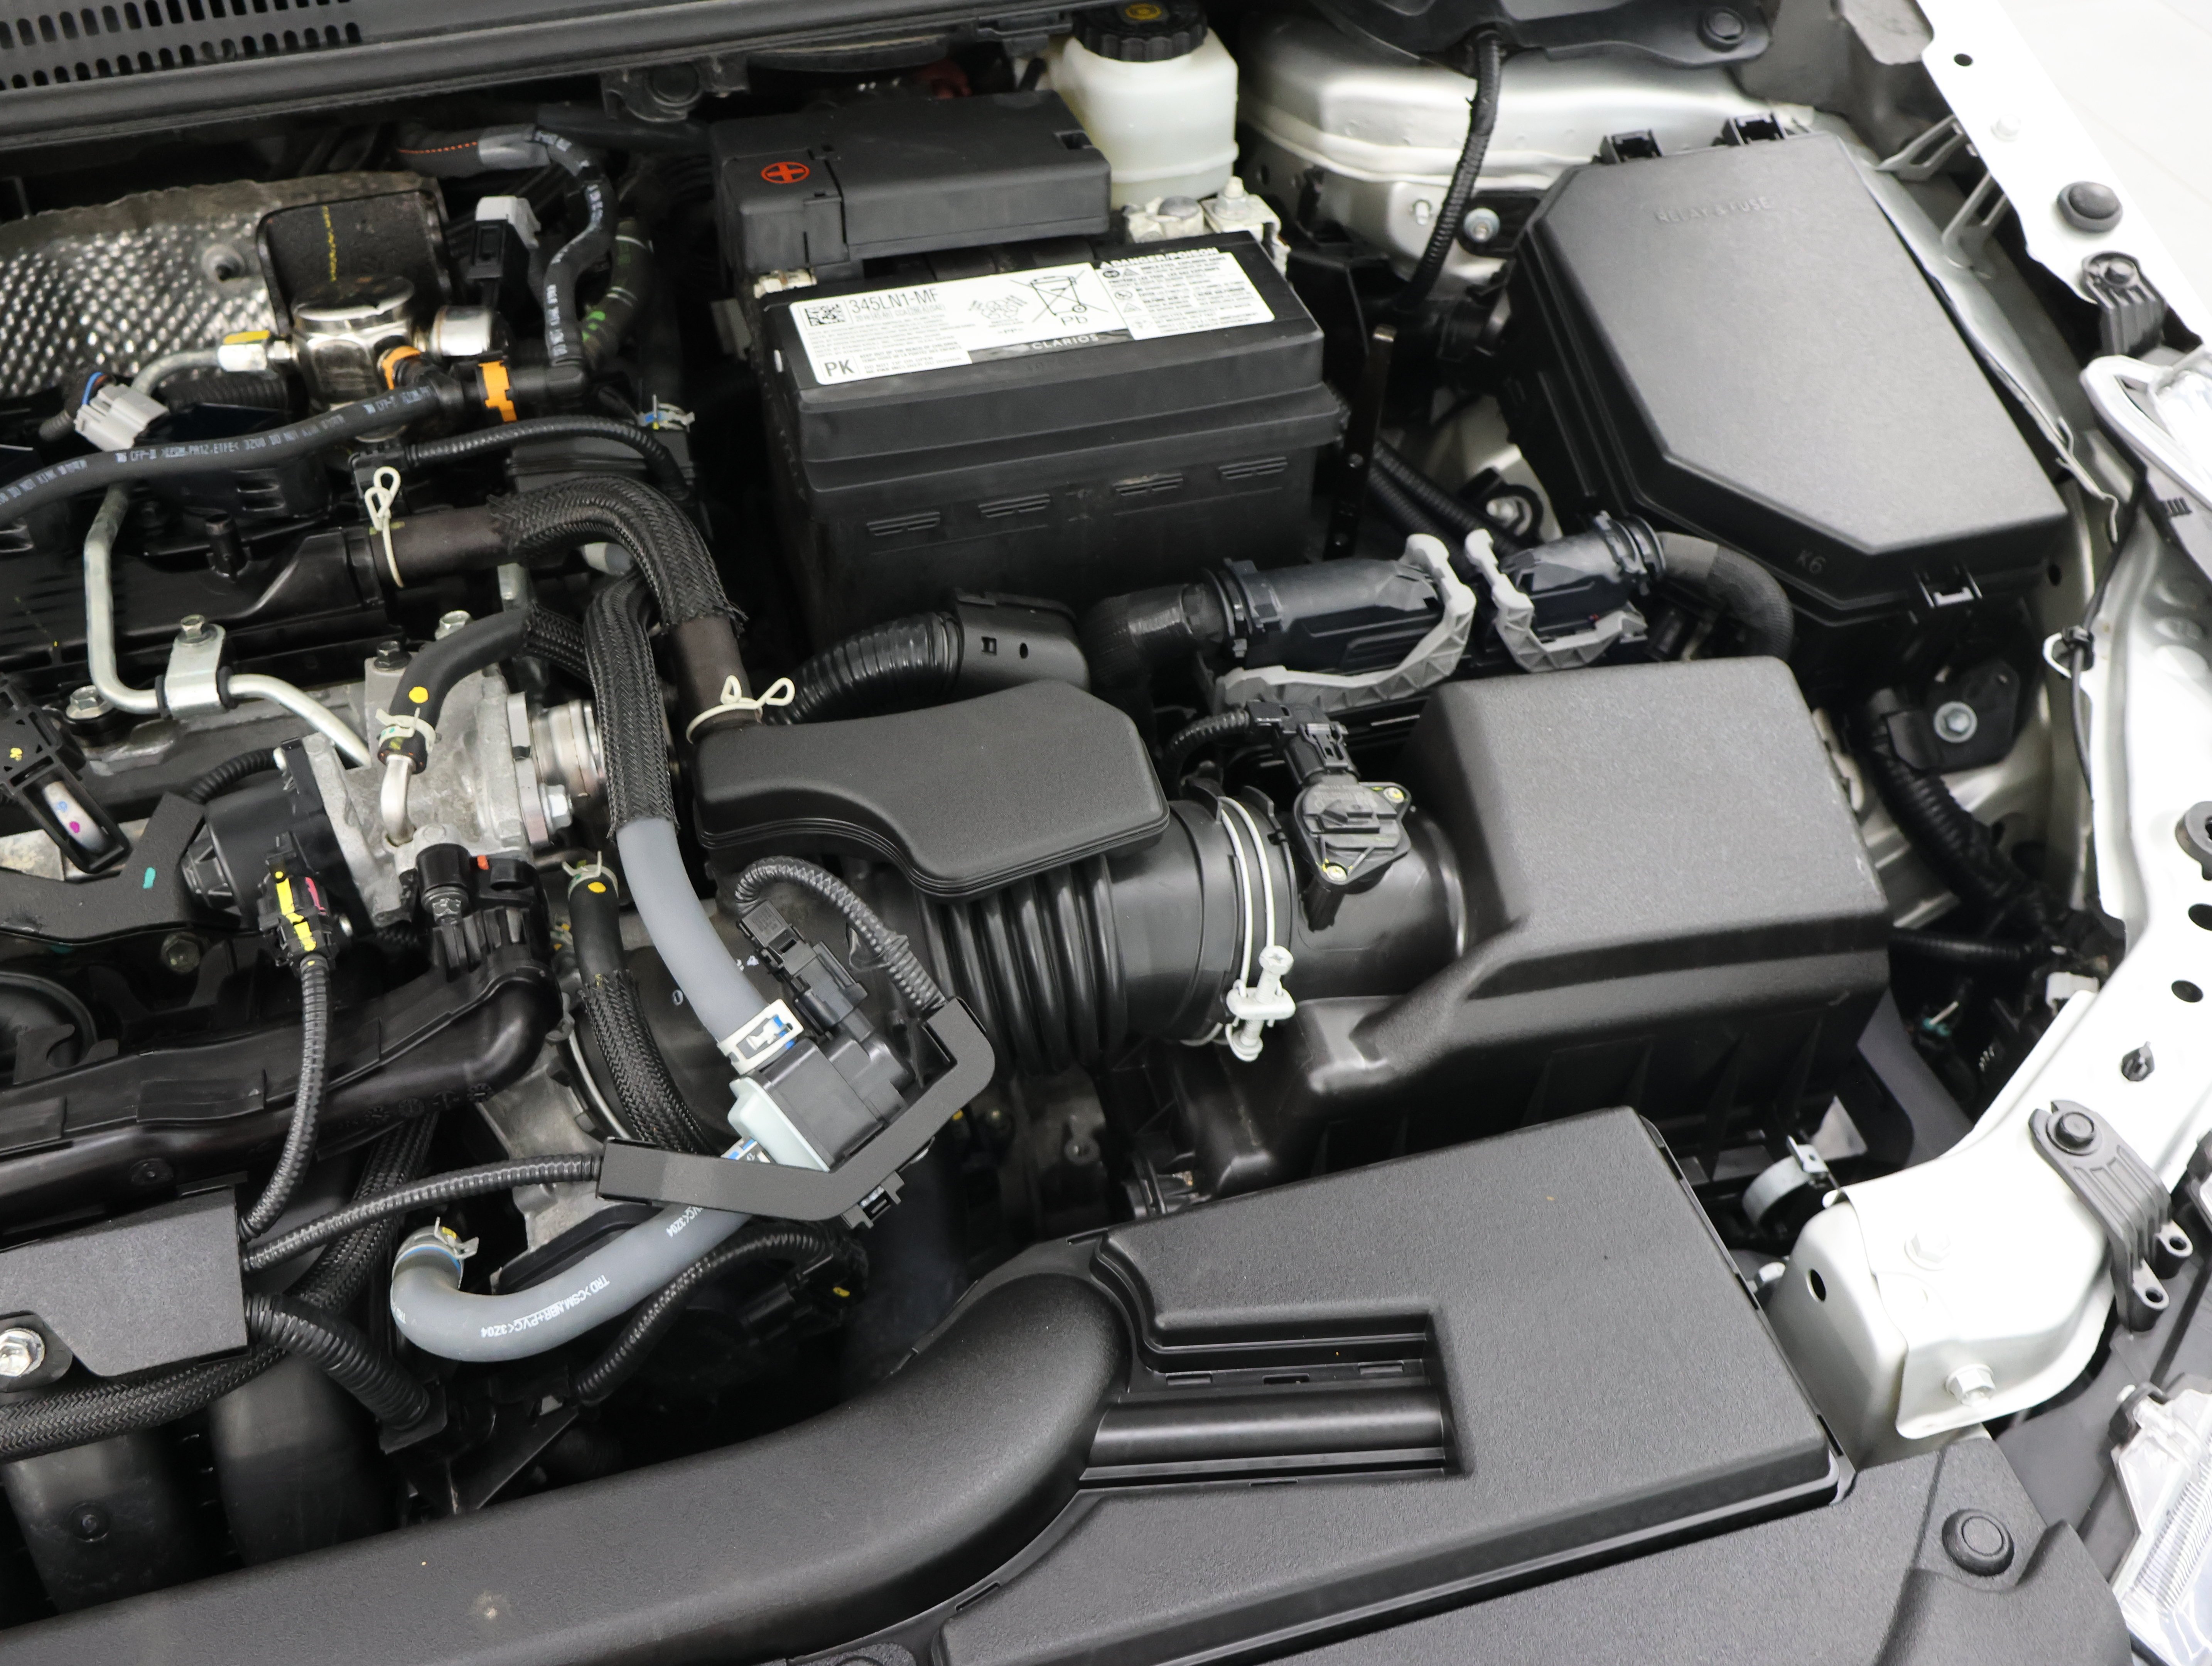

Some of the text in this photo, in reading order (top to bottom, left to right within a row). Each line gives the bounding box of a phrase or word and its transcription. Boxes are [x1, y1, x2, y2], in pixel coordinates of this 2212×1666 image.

[849, 288, 940, 314] 345LN1-MF
[1060, 315, 1088, 325] Pb
[1031, 334, 1099, 350] CLARIOS
[824, 359, 855, 377] PK
